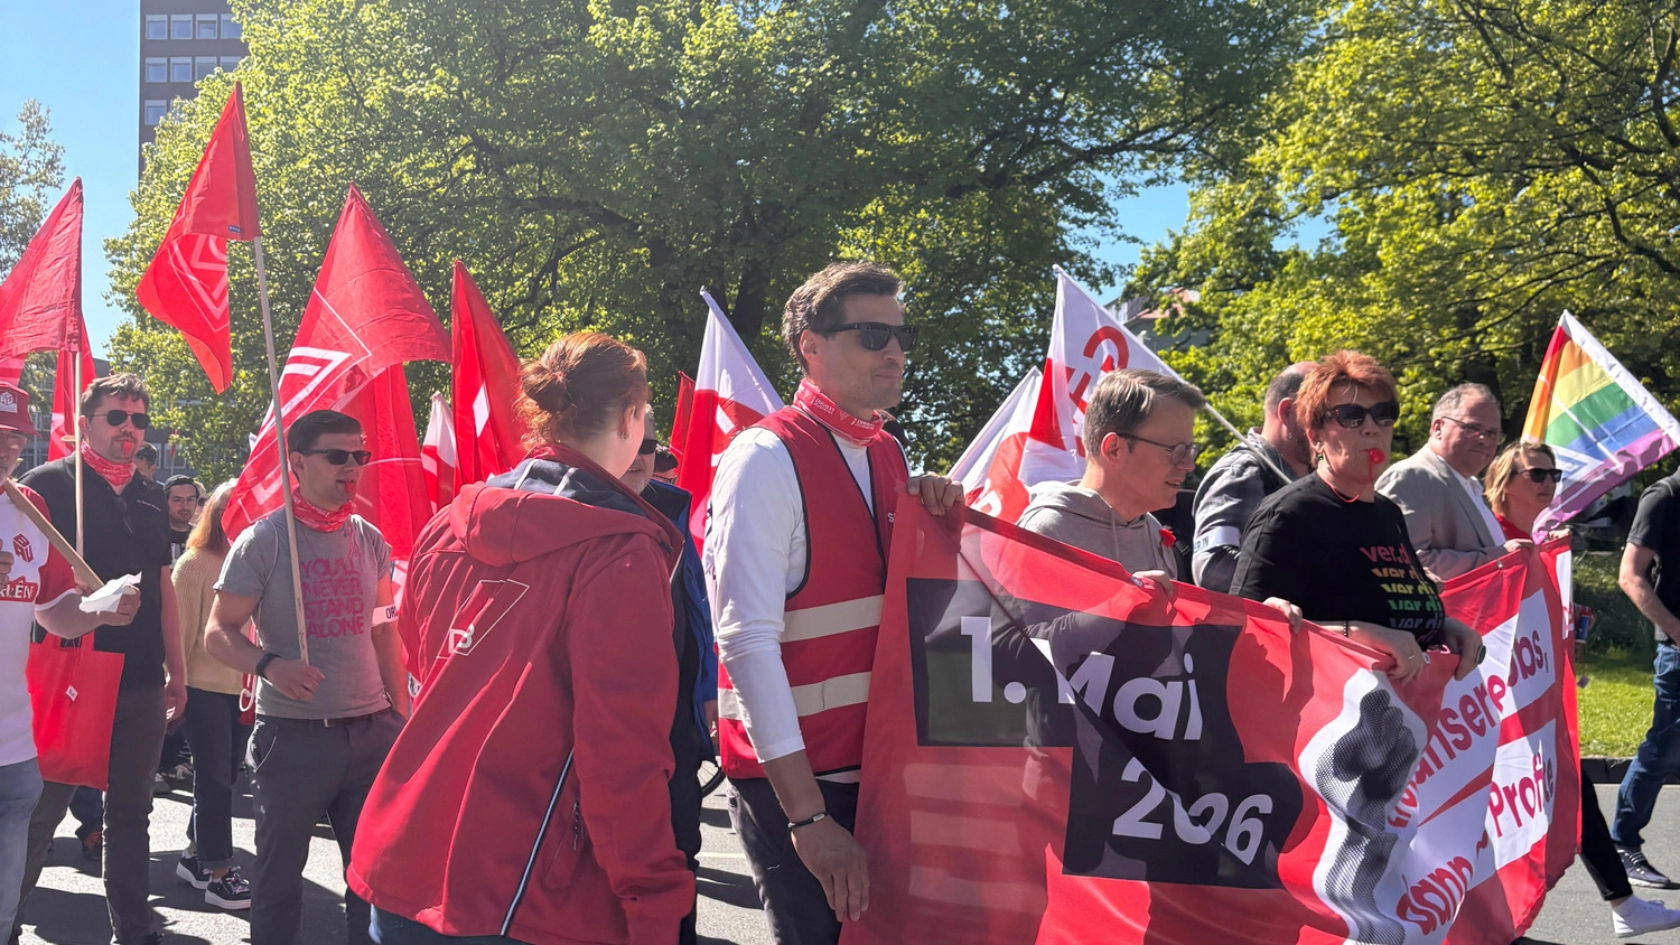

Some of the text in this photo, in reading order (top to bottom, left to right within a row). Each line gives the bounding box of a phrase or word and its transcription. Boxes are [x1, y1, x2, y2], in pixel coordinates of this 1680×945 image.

[1359, 543, 1411, 565] ver.d
[301, 577, 364, 599] NEVER
[306, 597, 364, 619] STAND
[306, 616, 364, 638] ALONE
[960, 616, 1203, 741] 1. Mai
